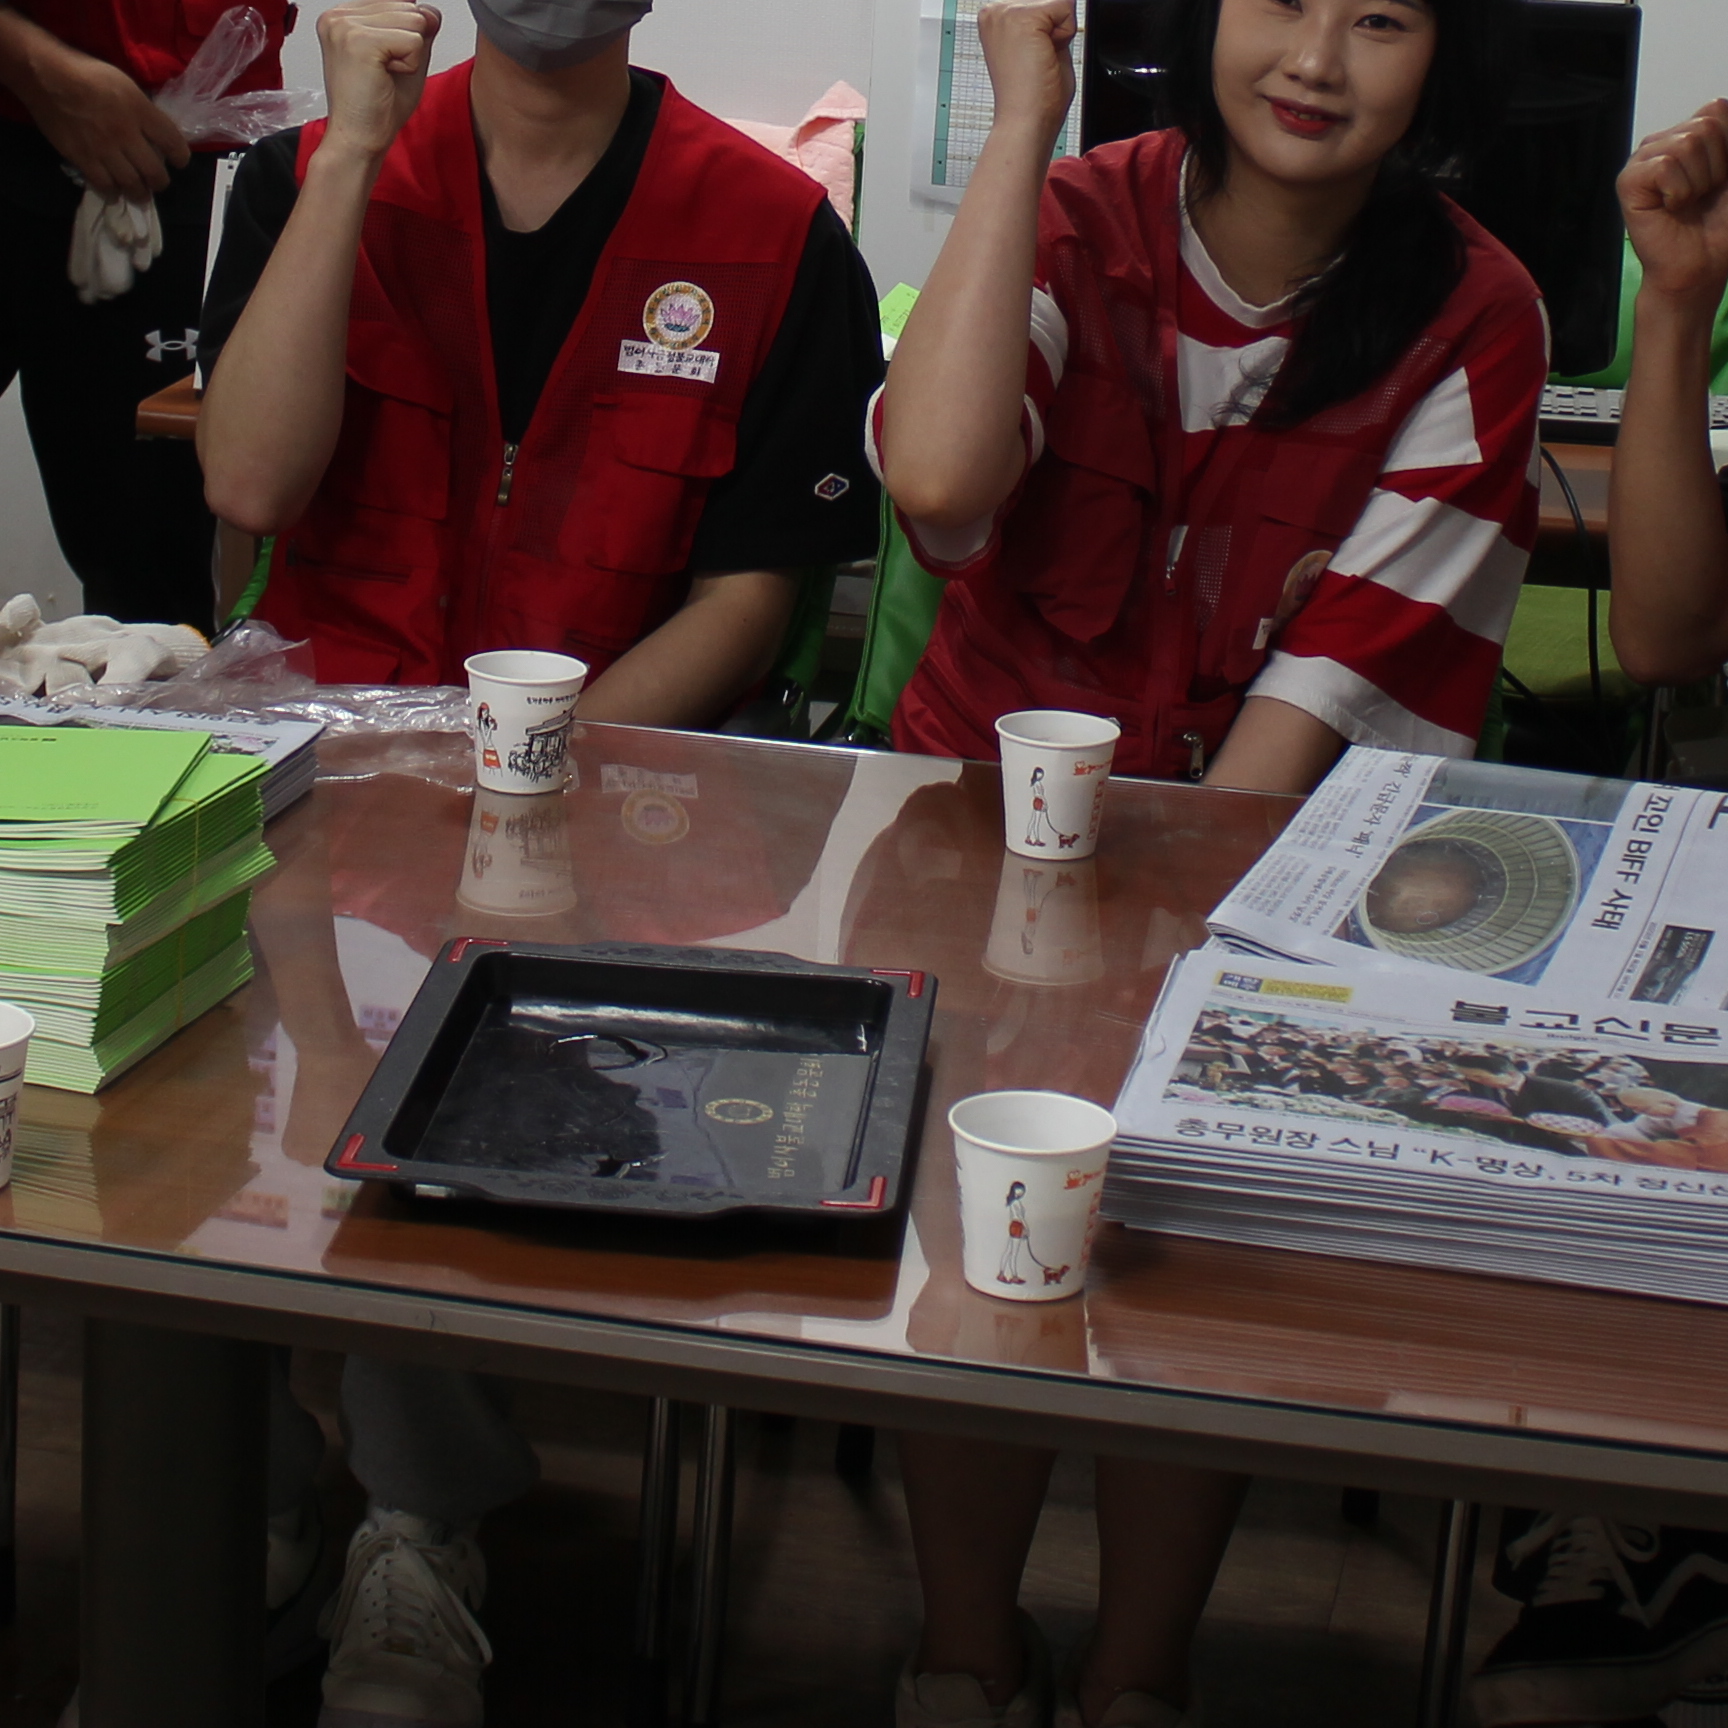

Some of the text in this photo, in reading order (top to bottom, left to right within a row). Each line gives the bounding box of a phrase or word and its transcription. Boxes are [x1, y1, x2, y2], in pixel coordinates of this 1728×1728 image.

[1591, 793, 1675, 931] 꼬인 BIFF 사태
[1450, 999, 1722, 1048] 불교신문
[1174, 1116, 1322, 1150] 총무원장
[1327, 1135, 1401, 1162] 스님
[1566, 1169, 1621, 1188] 5차
